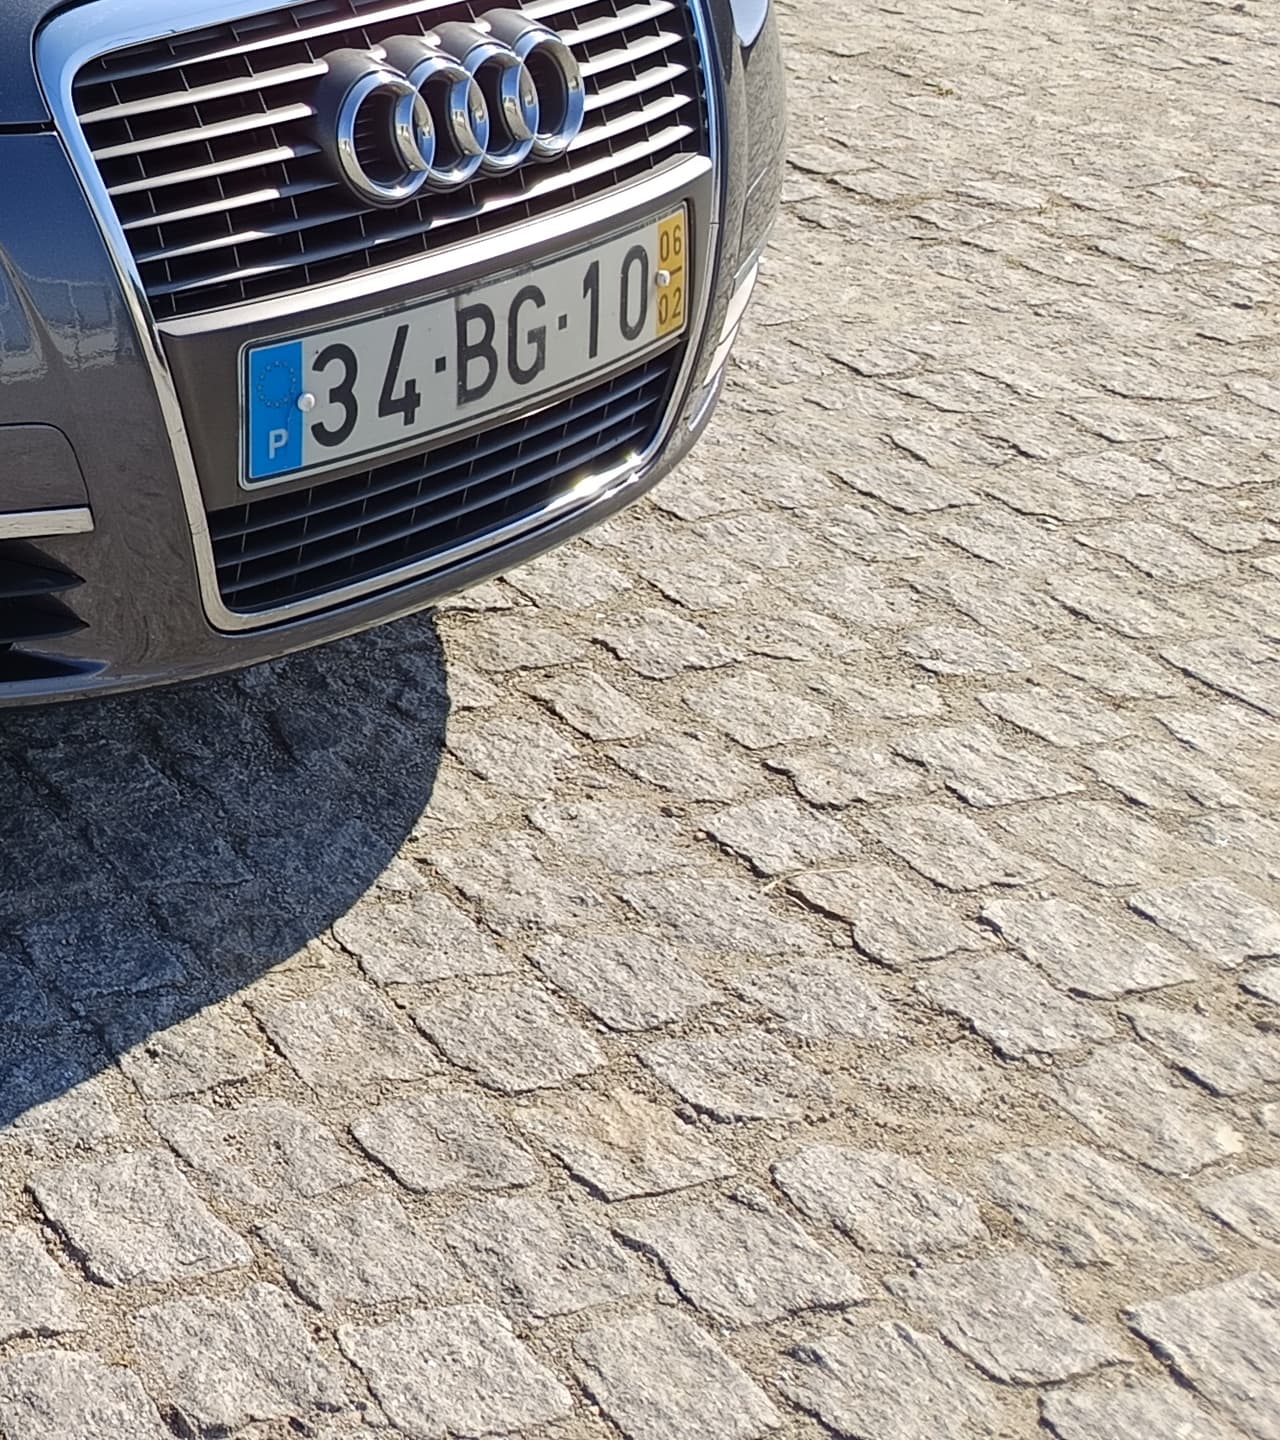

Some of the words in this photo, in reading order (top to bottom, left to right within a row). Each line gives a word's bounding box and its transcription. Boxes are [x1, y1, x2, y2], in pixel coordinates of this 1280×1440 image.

[660, 223, 683, 263] 06
[658, 287, 683, 326] 02
[269, 427, 288, 460] P
